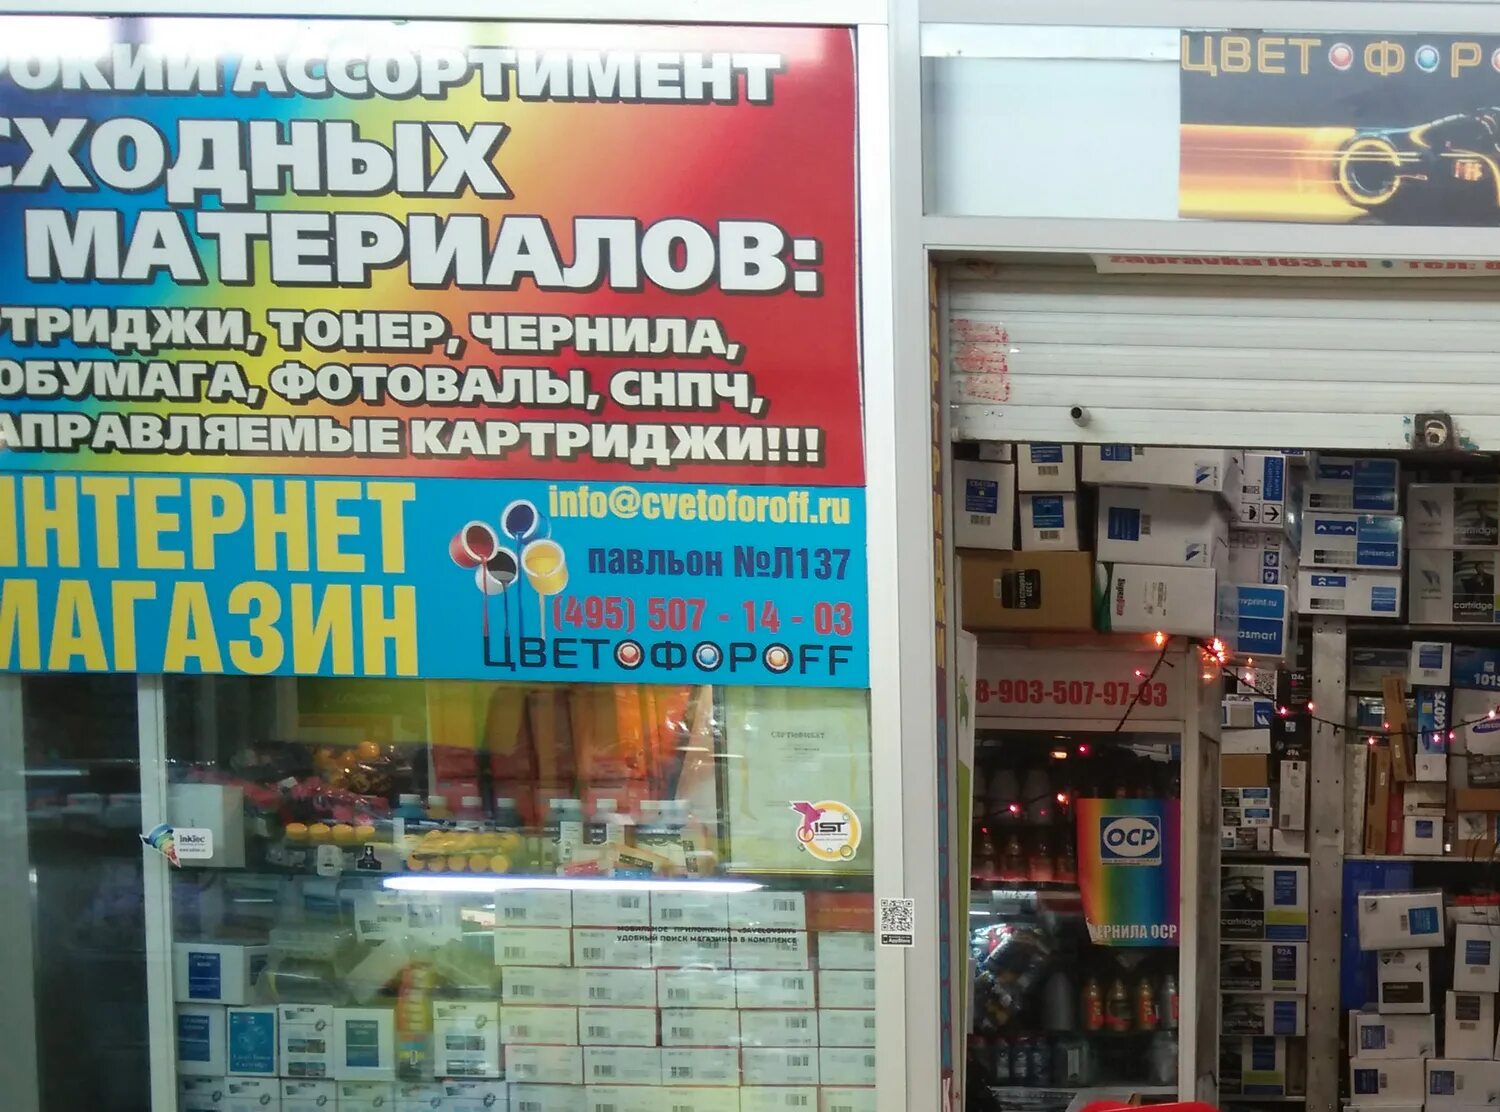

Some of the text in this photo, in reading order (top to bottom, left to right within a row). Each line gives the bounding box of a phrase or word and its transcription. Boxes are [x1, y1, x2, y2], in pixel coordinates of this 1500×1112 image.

[232, 48, 781, 104] АССОРТИМЕНТ
[0, 115, 511, 204] ХОДНЫХ
[25, 208, 824, 296] МАТЕРИАЛОВ:
[267, 309, 466, 358] ТОНЕР,
[470, 315, 742, 363] ЧЕРНИЛА,
[269, 363, 601, 416] ФОТОВАЛЫ,
[609, 370, 767, 419] СНПЧ,
[410, 418, 823, 467] КАРТРИДЖИ!!!
[548, 485, 851, 524] info@cvetoforoff.ru
[588, 547, 723, 577] павльон
[551, 595, 636, 632] (495)
[648, 596, 707, 632] 507
[741, 600, 781, 634] 14
[813, 601, 854, 637] 03
[1107, 828, 1155, 846] OCP
